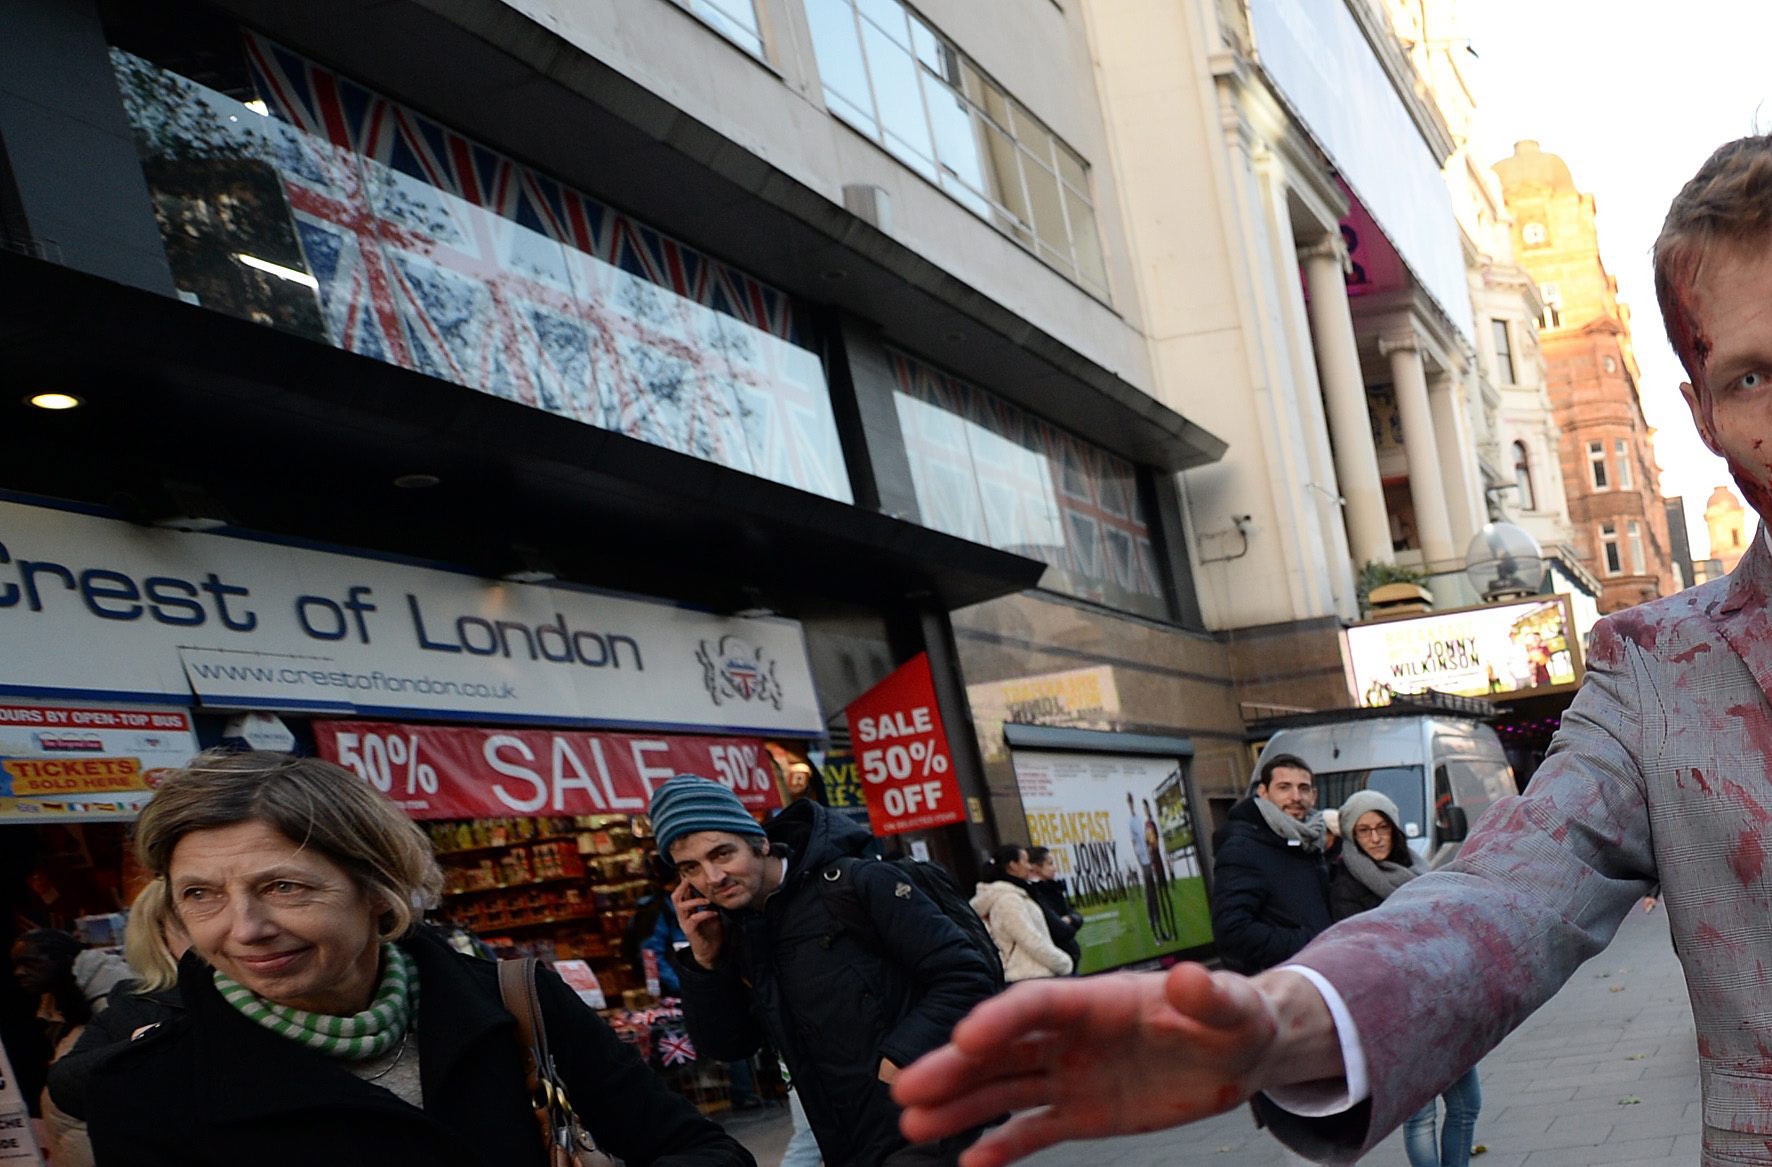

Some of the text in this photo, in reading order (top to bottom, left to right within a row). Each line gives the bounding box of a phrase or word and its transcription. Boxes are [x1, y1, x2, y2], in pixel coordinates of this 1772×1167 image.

[0, 540, 645, 671] rest of London
[1390, 653, 1481, 677] WILKINSON
[1427, 636, 1477, 659] JONNY
[193, 663, 517, 699] www.crestoflondon.co.uk
[0, 709, 183, 728] OURS BY OPEN-TOP BUS
[858, 707, 933, 742] SALE
[12, 760, 134, 778] TICKETS
[336, 731, 439, 796] 50%
[708, 744, 770, 791] 50%
[862, 740, 948, 784] 50%
[28, 777, 129, 790] SOLD HERE
[883, 781, 943, 817] OFF
[1026, 811, 1112, 847] BREAKFAST
[1050, 841, 1119, 874] TH JONNY
